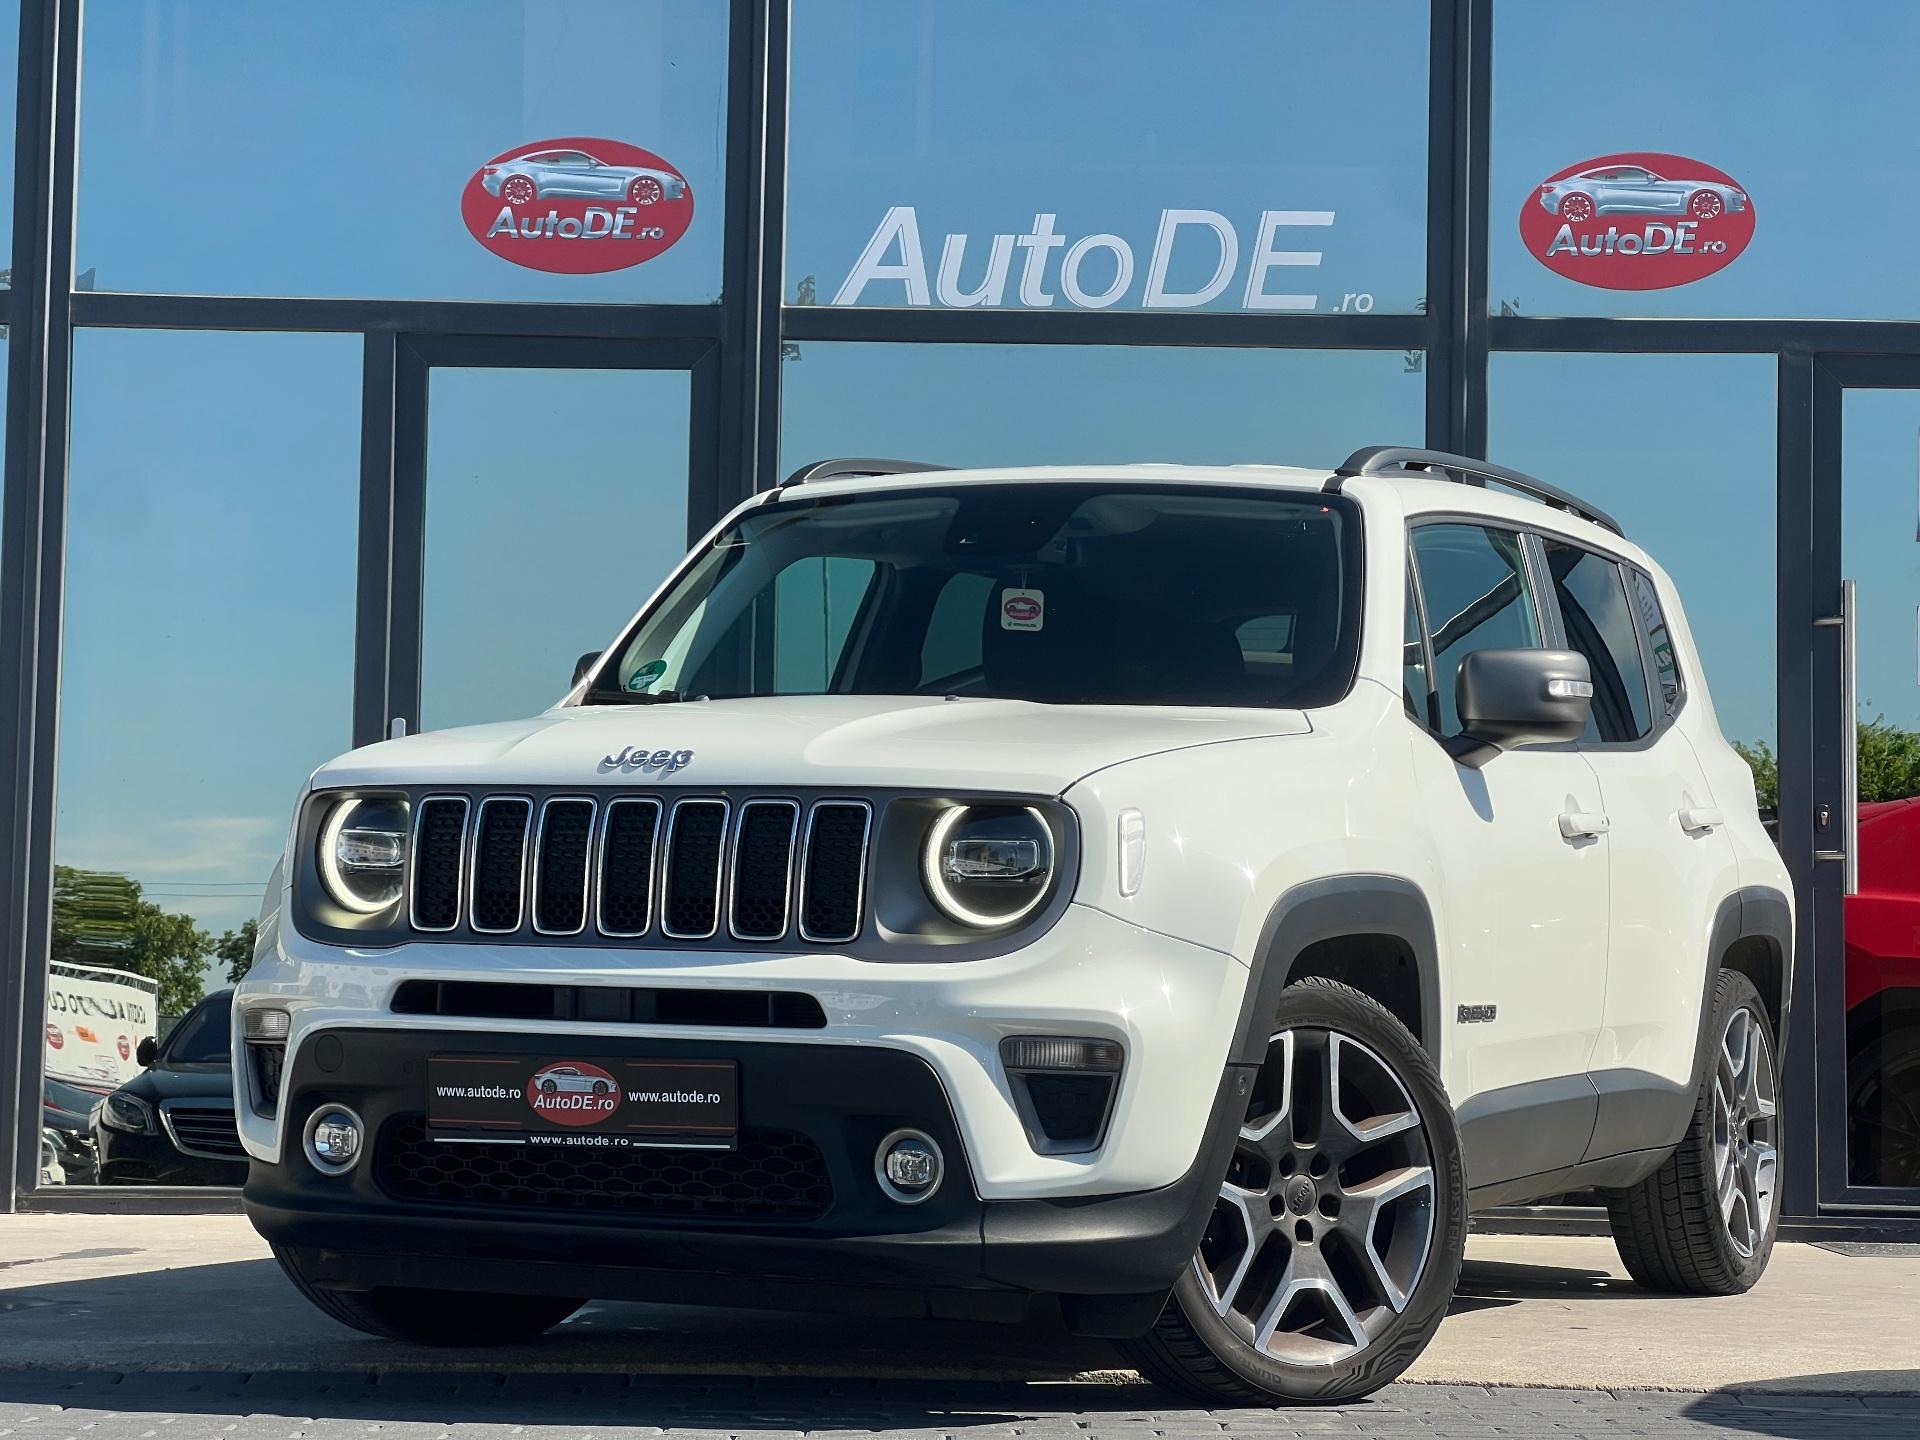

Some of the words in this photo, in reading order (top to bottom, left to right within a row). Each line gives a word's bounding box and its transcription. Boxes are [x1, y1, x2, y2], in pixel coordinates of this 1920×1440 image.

[604, 745, 695, 772] Jeep
[436, 1084, 522, 1100] www.autode.ro
[628, 1089, 721, 1105] www.autode.ro
[533, 1093, 615, 1112] AutoDE.ro
[530, 1134, 629, 1147] www.autode.ro
